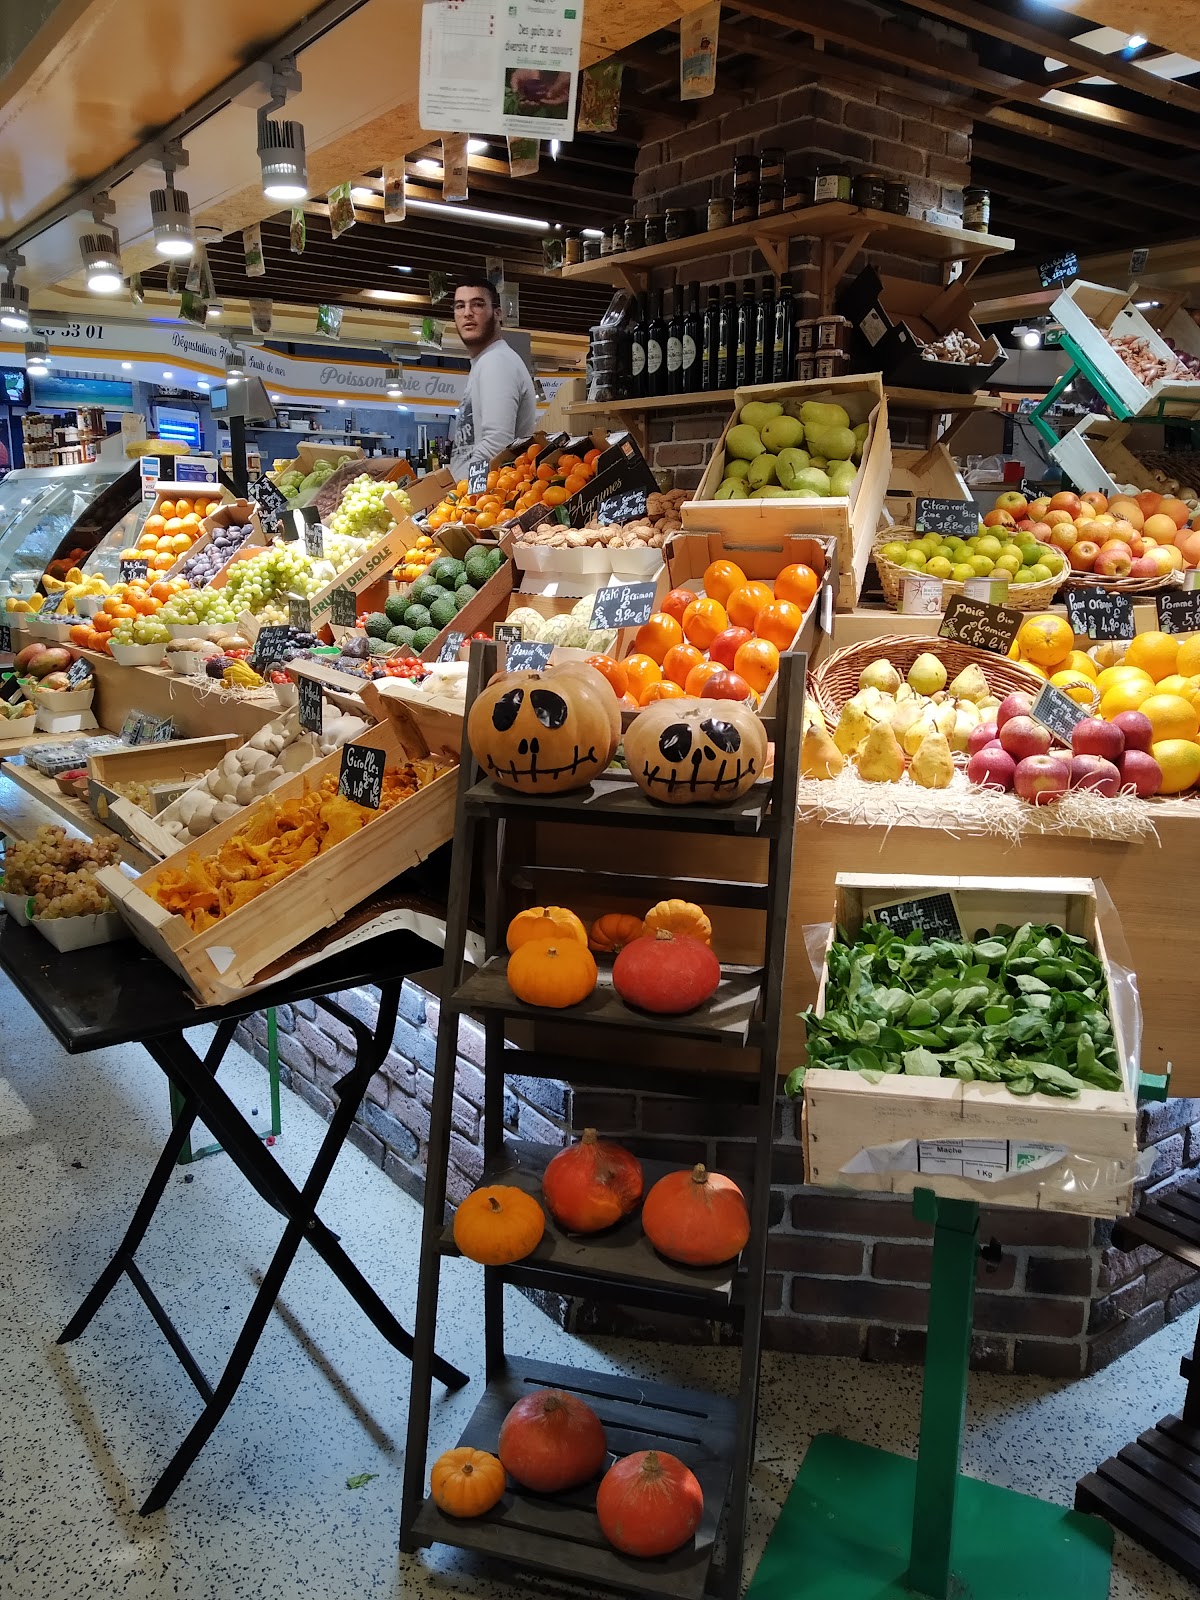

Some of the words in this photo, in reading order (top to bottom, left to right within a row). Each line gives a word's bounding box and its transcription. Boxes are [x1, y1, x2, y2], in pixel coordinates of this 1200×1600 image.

[86, 324, 104, 340] 01
[172, 331, 217, 358] Dégustations
[266, 361, 274, 374] de
[425, 375, 456, 396] Jan
[346, 567, 368, 588] DEL
[365, 545, 393, 572] SOLE
[1161, 595, 1193, 610] Pomme
[960, 624, 986, 645] 6.80
[977, 617, 1012, 639] Comice
[347, 747, 379, 775] Girolles
[363, 771, 374, 784] Bio
[880, 903, 924, 926] Salade
[936, 1145, 962, 1154] Mache
[982, 1169, 993, 1179] Kg
